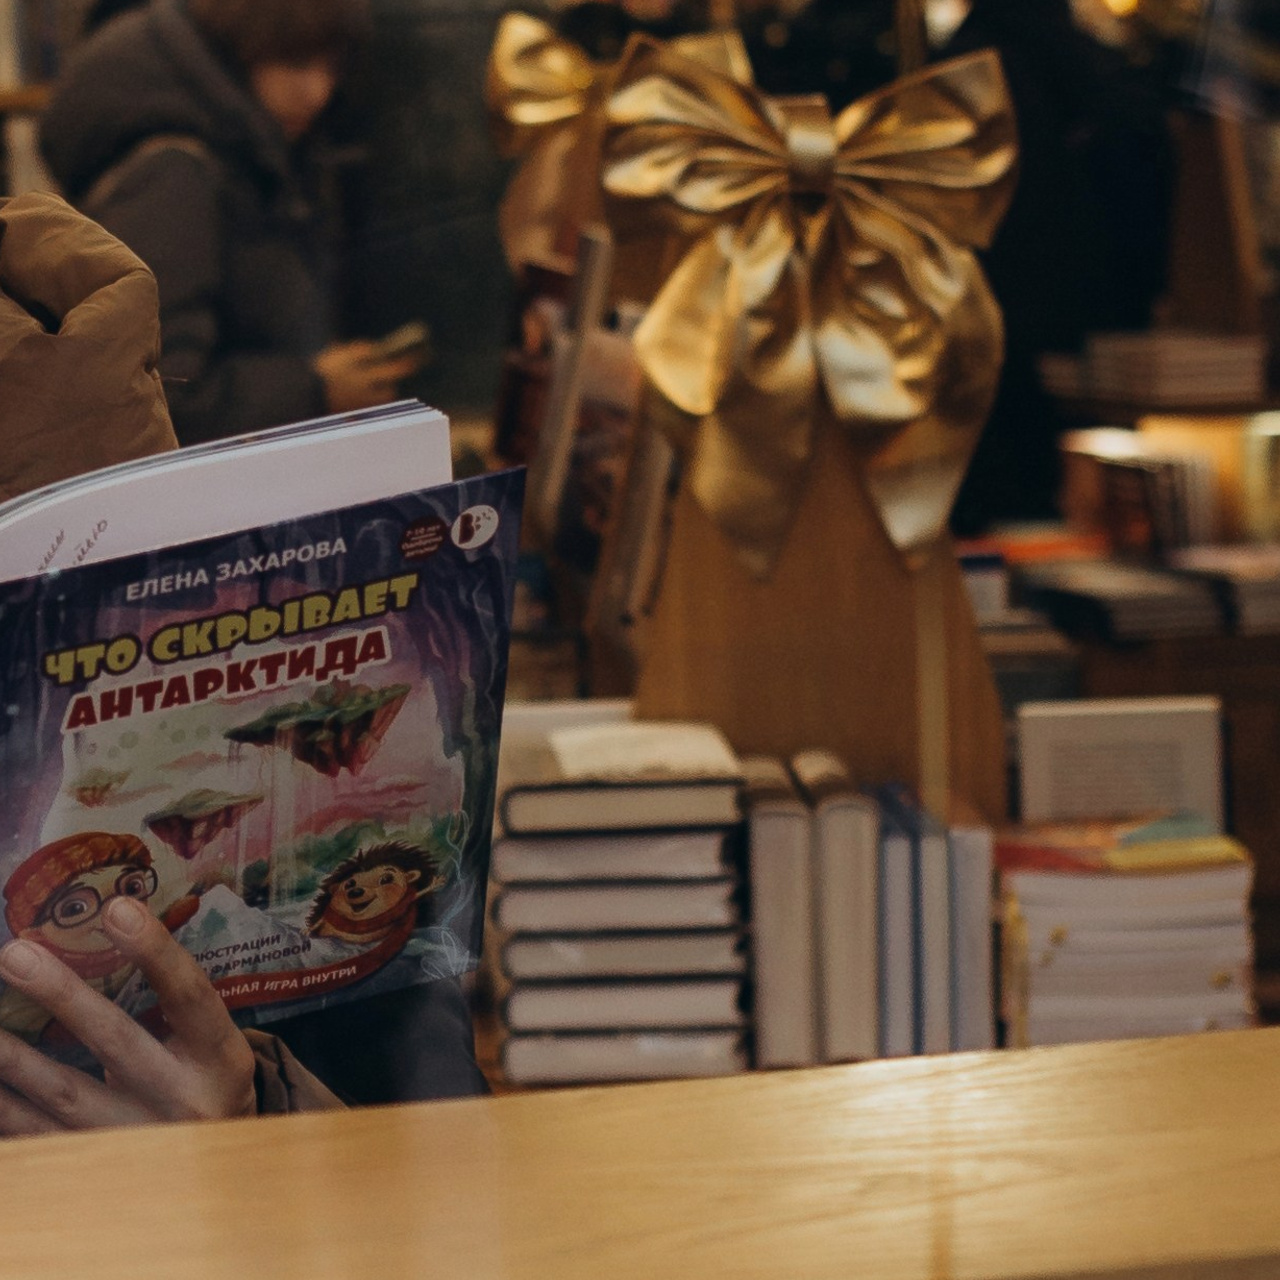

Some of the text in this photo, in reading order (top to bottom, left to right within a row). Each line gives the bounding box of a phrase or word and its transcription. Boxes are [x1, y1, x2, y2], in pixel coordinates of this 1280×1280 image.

[125, 537, 348, 602] ЕЛЕНА ЗАХАРОВА
[44, 573, 419, 685] ЧТО СКРЫВАЕТ
[65, 629, 388, 730] АНТАРКТИДА
[193, 933, 281, 963] ЛЮСТРАЦИИ
[210, 939, 312, 975] ФАРМАНОВОЙ
[263, 977, 299, 992] ИГРА
[302, 964, 358, 988] ВНУТРИ
